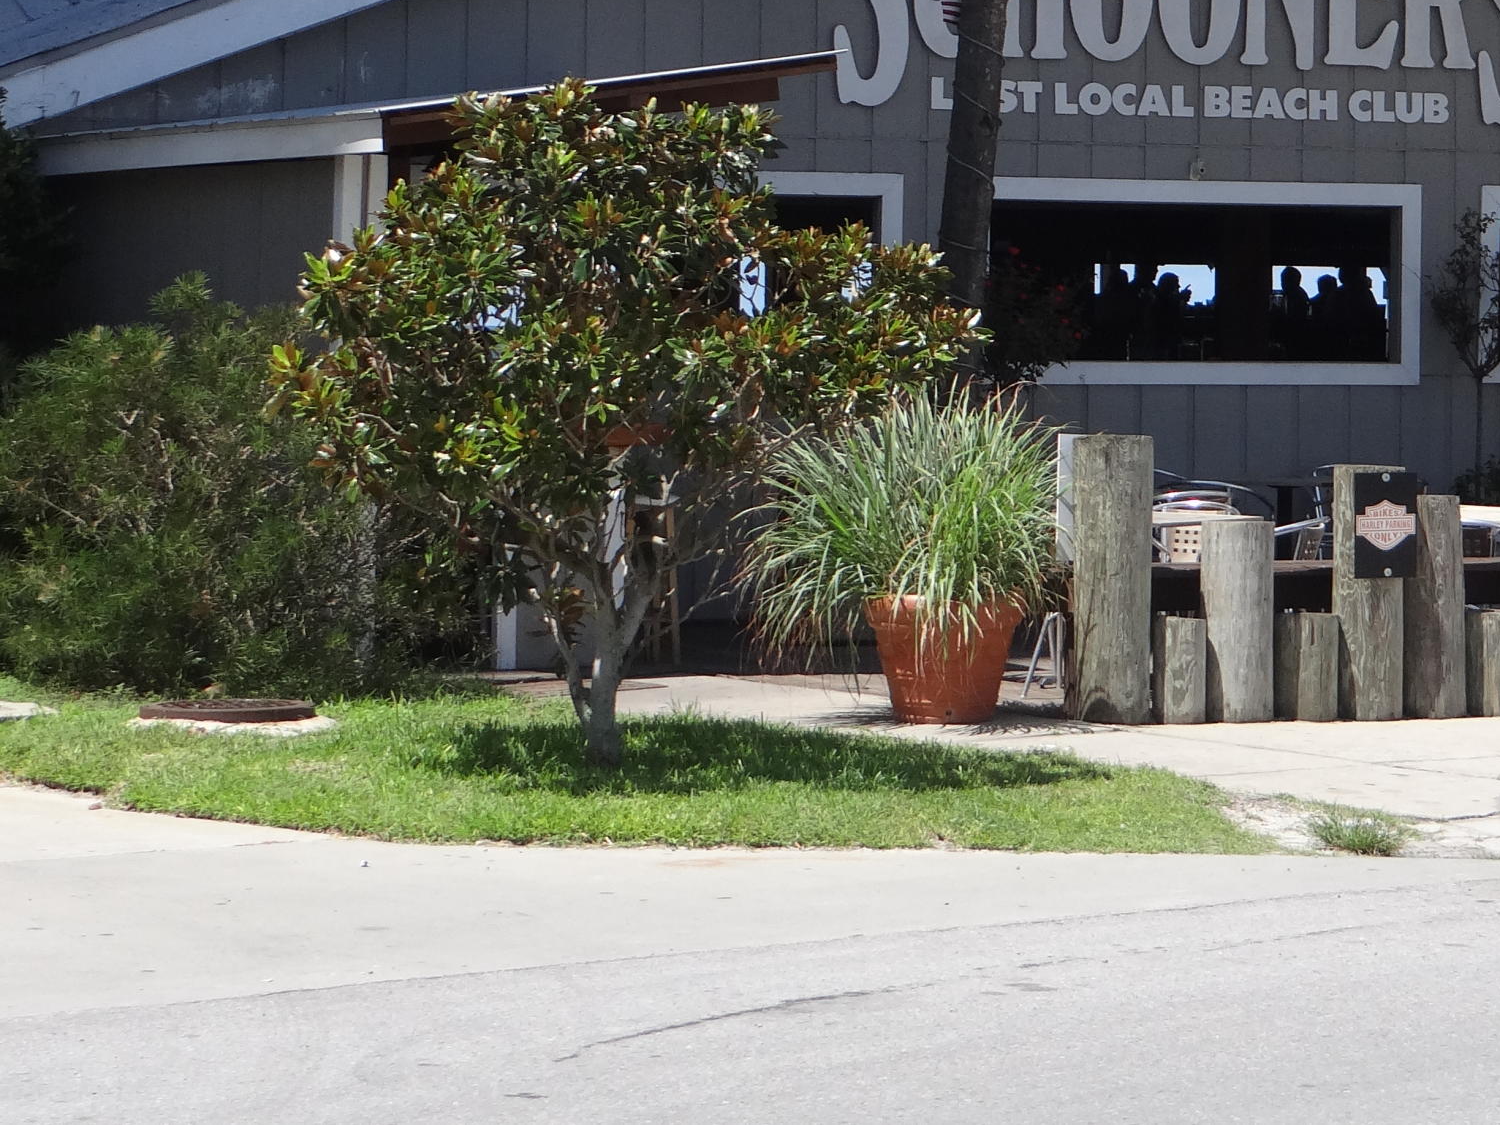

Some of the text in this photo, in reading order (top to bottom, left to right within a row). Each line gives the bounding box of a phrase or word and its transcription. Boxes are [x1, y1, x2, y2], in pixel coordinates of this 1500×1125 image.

[931, 77, 1450, 123] LST LOCAL BEACH CLUB
[1361, 519, 1411, 529] HARLEY PARKING
[1374, 532, 1398, 543] ONLY
